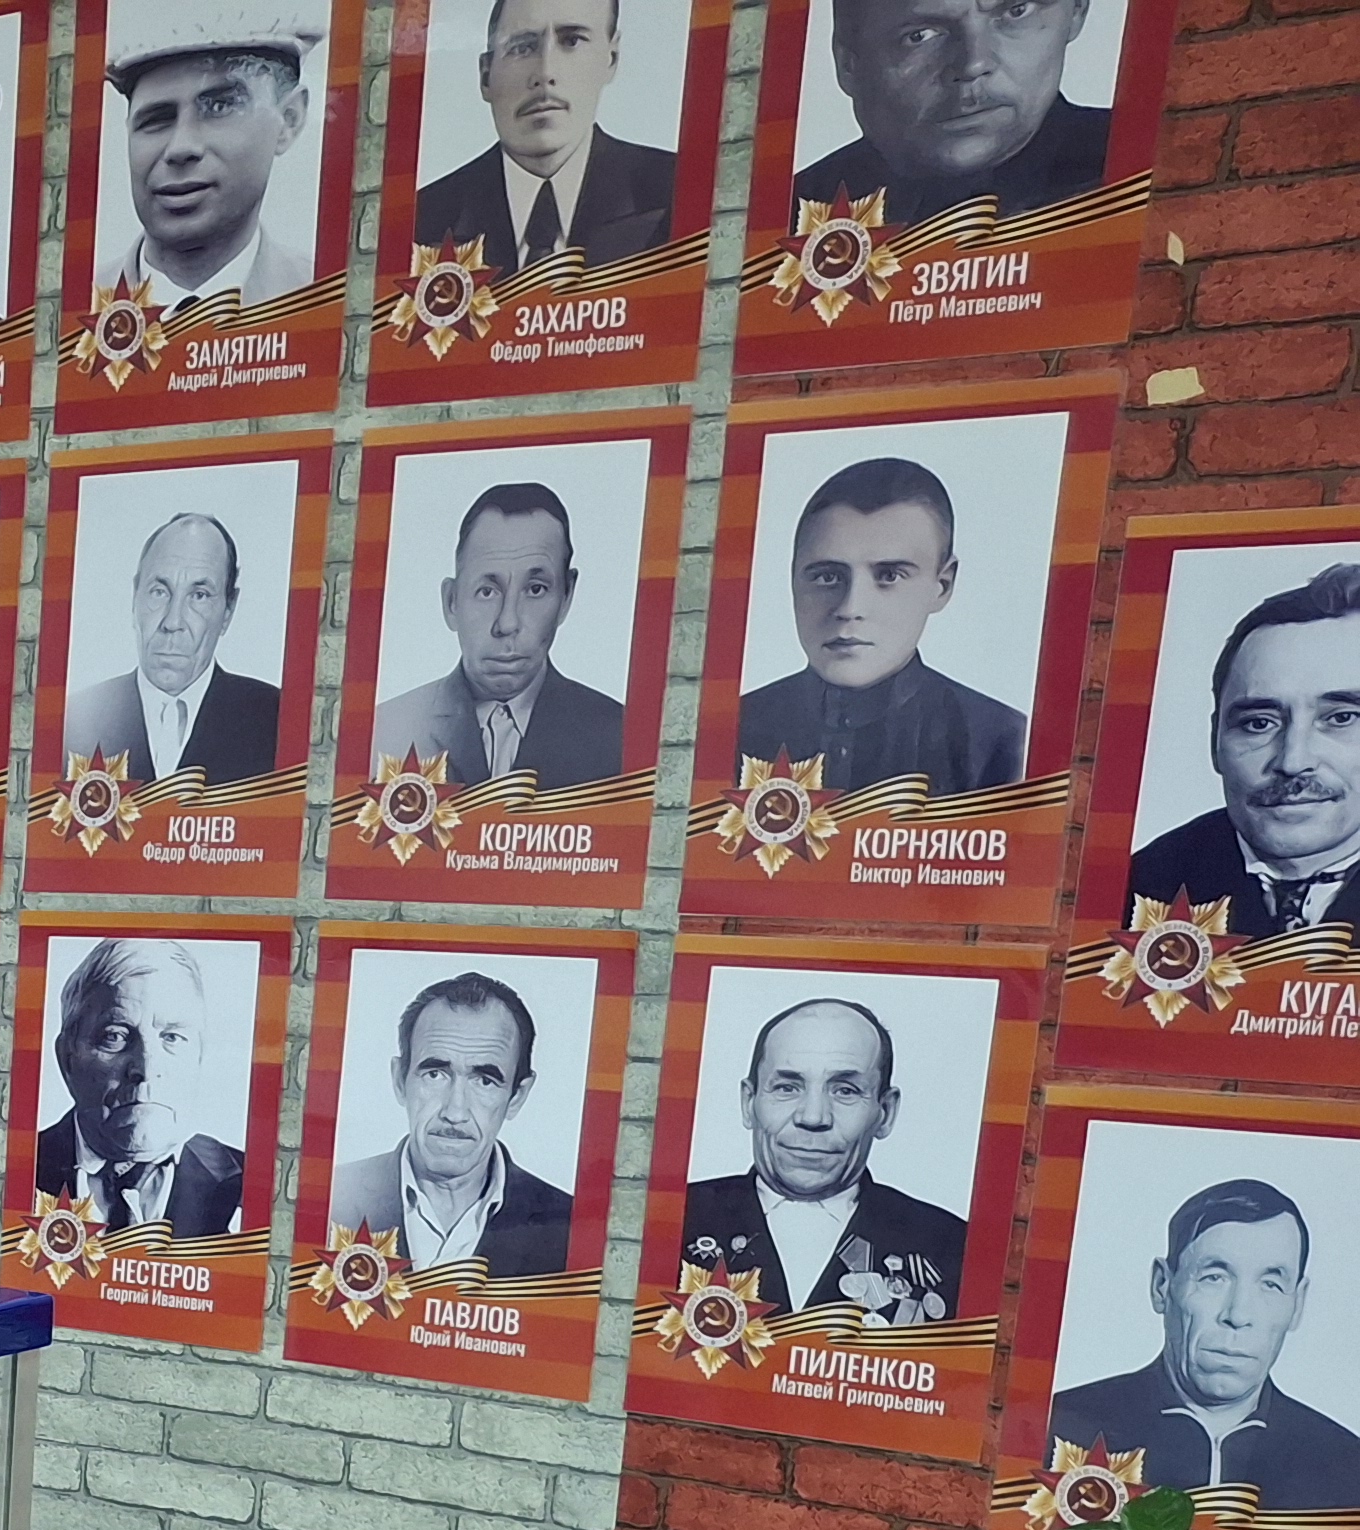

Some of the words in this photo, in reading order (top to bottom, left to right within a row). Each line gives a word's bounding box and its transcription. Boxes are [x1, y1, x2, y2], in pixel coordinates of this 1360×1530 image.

[911, 251, 1029, 297] ЗВЯГИН
[514, 296, 627, 337] ЗАХАРОВ
[888, 299, 933, 325] Пётр
[939, 291, 1043, 319] Матвеевич
[184, 332, 287, 369] ЗАМЯТИН
[489, 338, 542, 364] Фёдор
[545, 333, 645, 358] Тимофеевич
[167, 369, 218, 392] Андрей
[219, 362, 307, 388] Дмитриевич
[167, 816, 236, 843] КОНЕВ
[478, 822, 592, 853] КОРИКОВ
[852, 827, 1008, 862] КОРНЯКОВ
[142, 842, 185, 865] Фёдор
[188, 842, 264, 865] Фёдорович
[445, 849, 498, 872] Кузьма
[503, 851, 619, 875] Владимирович
[849, 863, 912, 887] Виктор
[916, 863, 1007, 887] Иванович
[1279, 980, 1357, 1018] КУГА
[1229, 1008, 1324, 1039] Дмитрий
[111, 1258, 211, 1293] НЕСТЕРОВ
[99, 1282, 149, 1306] Георгий
[150, 1288, 214, 1314] Иванович
[424, 1297, 521, 1336] ПАВЛОВ
[409, 1325, 451, 1349] Юрий
[453, 1331, 526, 1358] Иванович
[787, 1345, 936, 1394] ПИЛЕНКОВ
[770, 1373, 834, 1401] Матвей
[837, 1383, 946, 1417] Григорьевич
